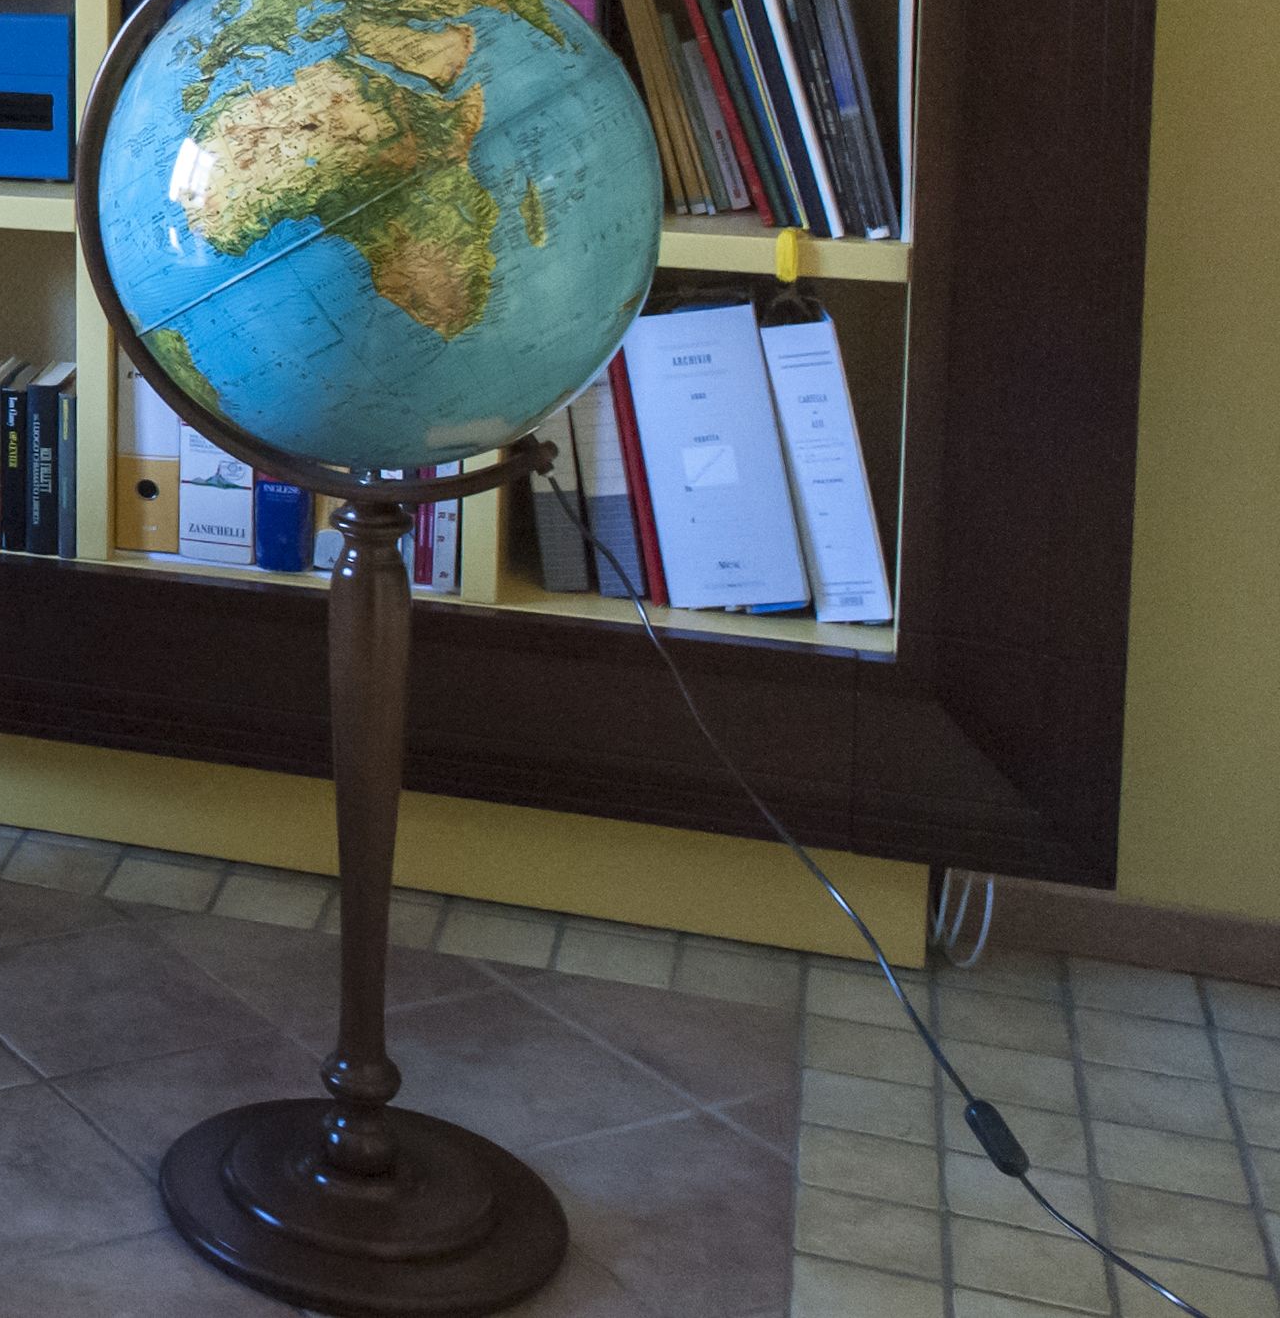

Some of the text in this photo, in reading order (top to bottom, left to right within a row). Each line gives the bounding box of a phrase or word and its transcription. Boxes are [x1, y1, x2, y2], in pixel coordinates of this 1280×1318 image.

[672, 354, 712, 367] ARCHIVIO
[6, 396, 17, 427] Tom Clancy
[189, 523, 246, 539] ZANICHELLI
